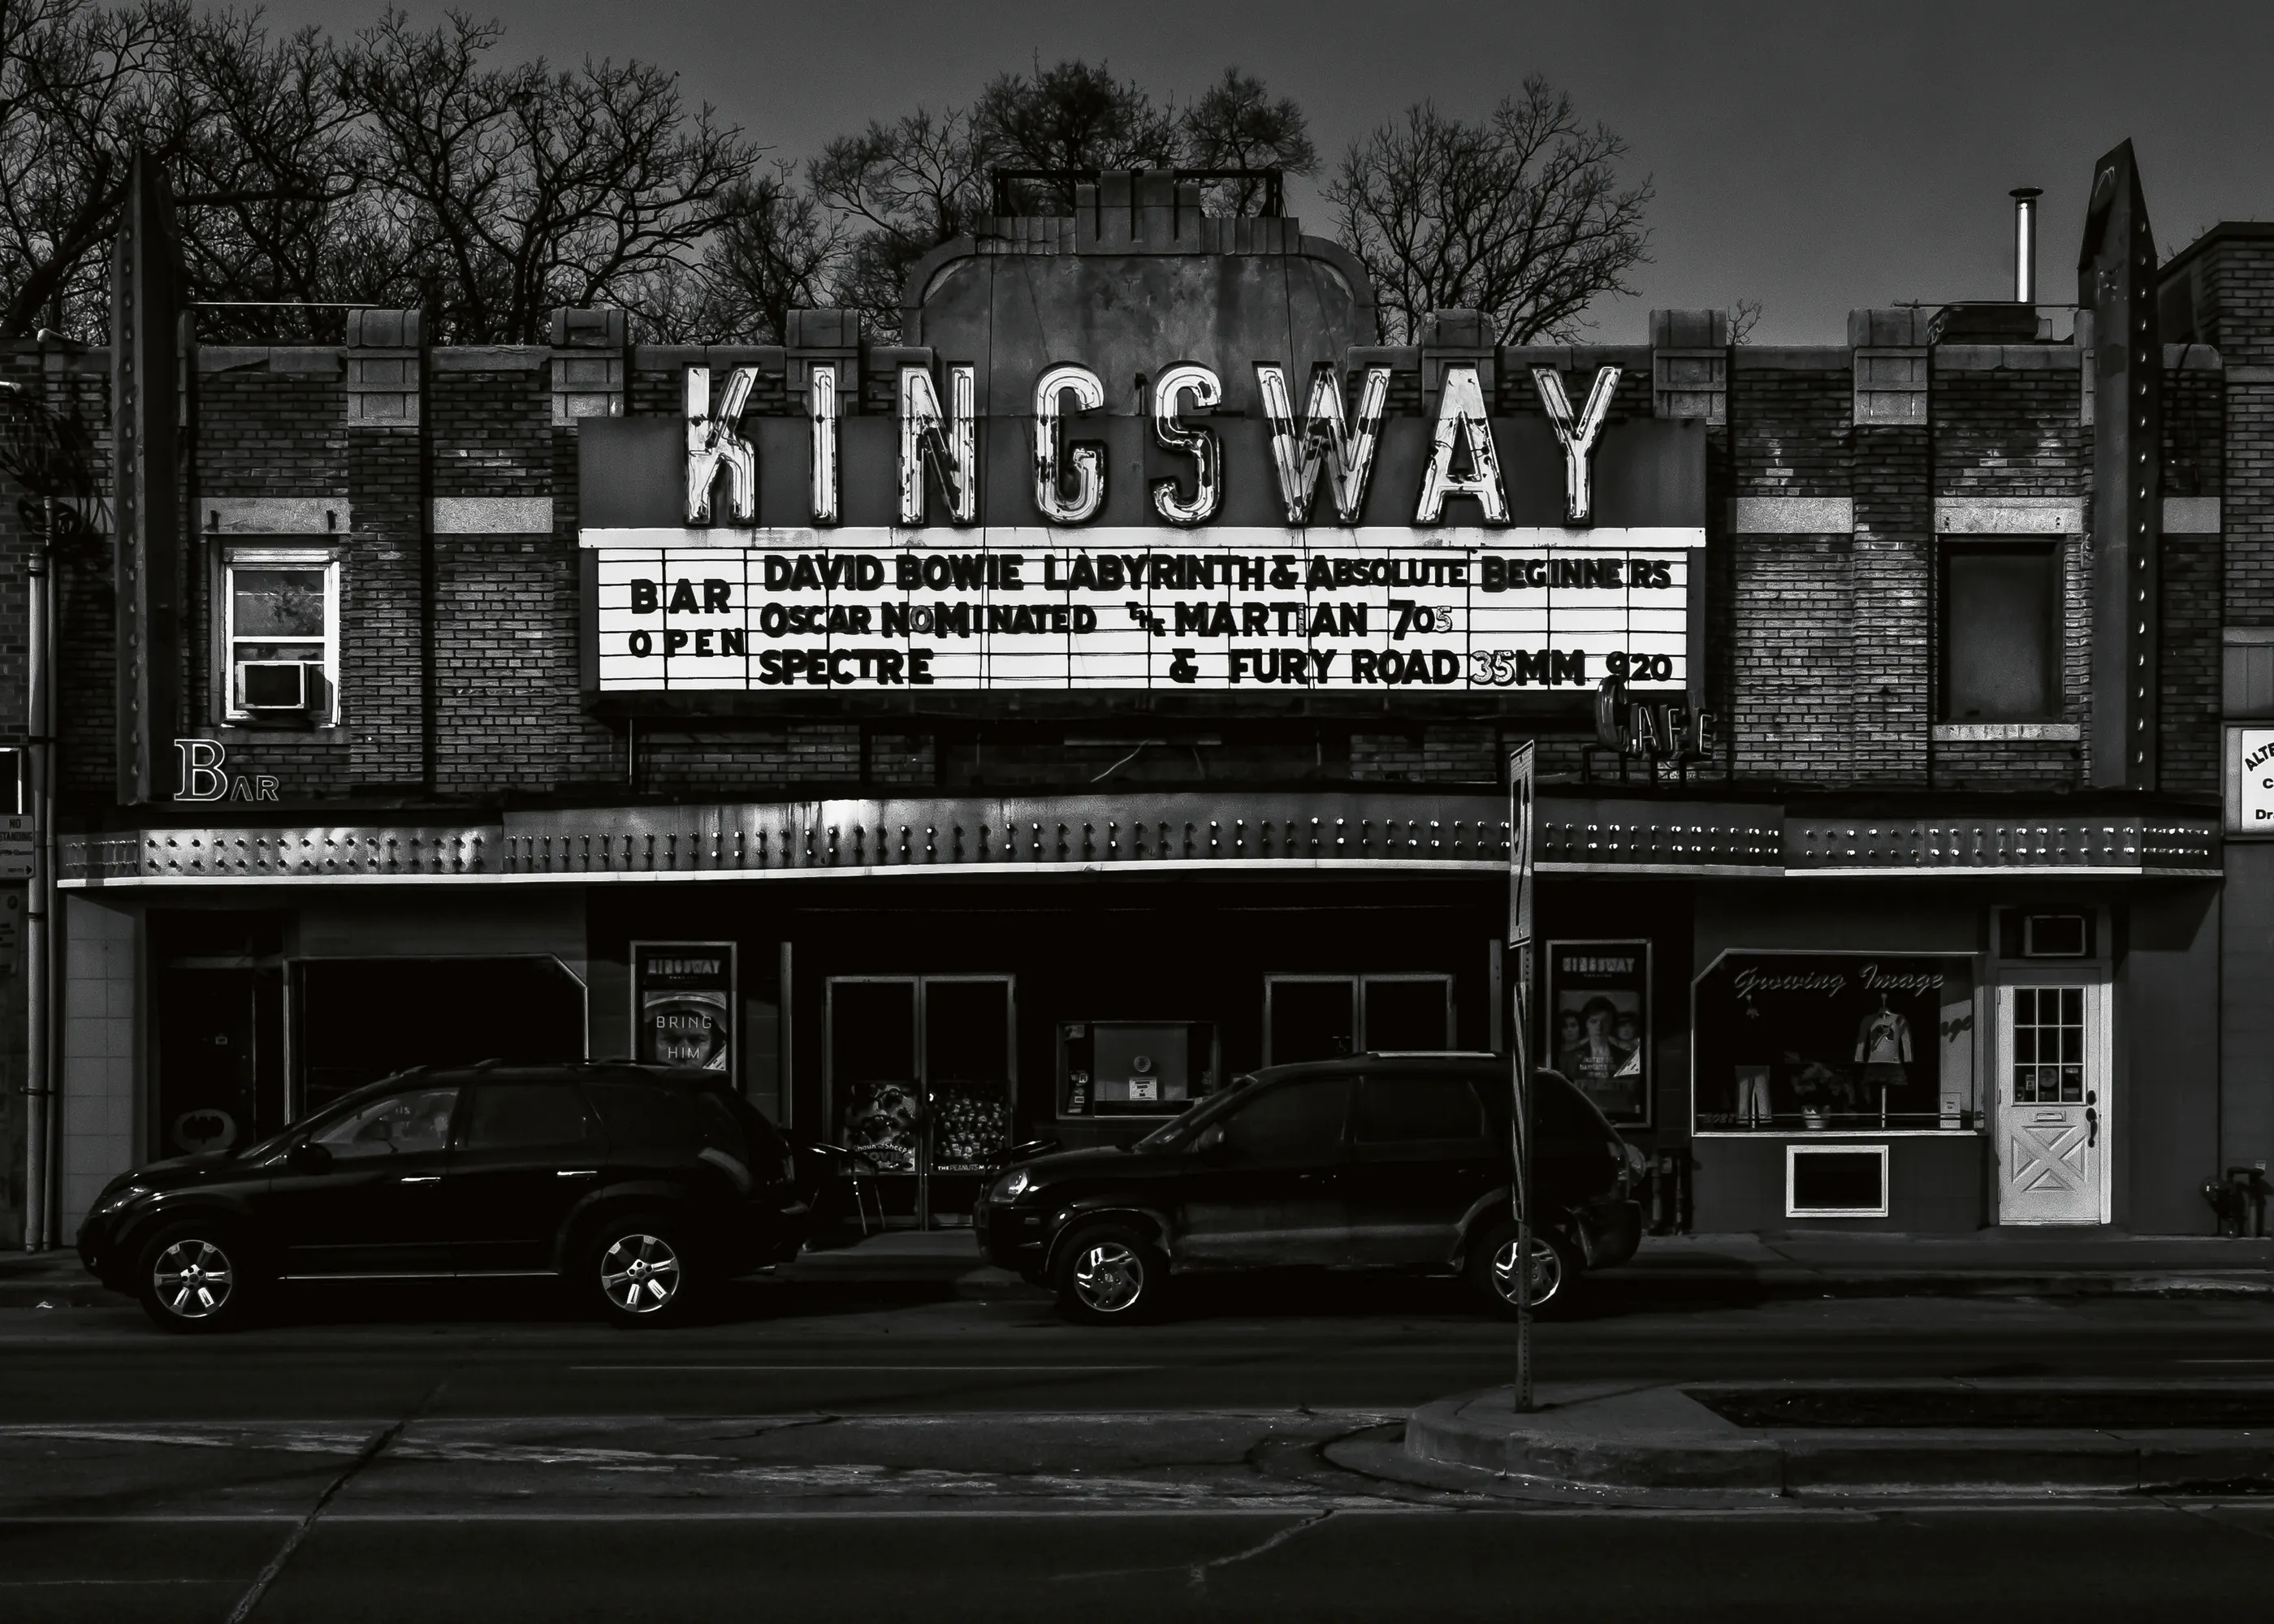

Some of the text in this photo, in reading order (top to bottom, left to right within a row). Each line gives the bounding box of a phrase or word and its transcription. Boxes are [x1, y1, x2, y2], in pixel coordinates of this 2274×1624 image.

[681, 361, 1625, 528] KINGSWAY
[763, 553, 1671, 593] DAVID BOWIE LABYRINTH & ABSOLUTE BEGINNERS
[631, 579, 730, 614] BAR
[759, 602, 871, 637] OSCAR
[881, 602, 1096, 637] NOMINATED
[1174, 601, 1367, 637] MARTIAN
[1388, 600, 1453, 640] 705
[629, 629, 746, 657] OPEN
[759, 649, 1672, 685] SPECTRE & FURY ROAD 35MM 920
[1596, 675, 1718, 760] CAFE
[9, 818, 21, 829] NO
[1733, 963, 1944, 999] Growing Image
[656, 1016, 712, 1029] BRING
[668, 1047, 700, 1059] HIM
